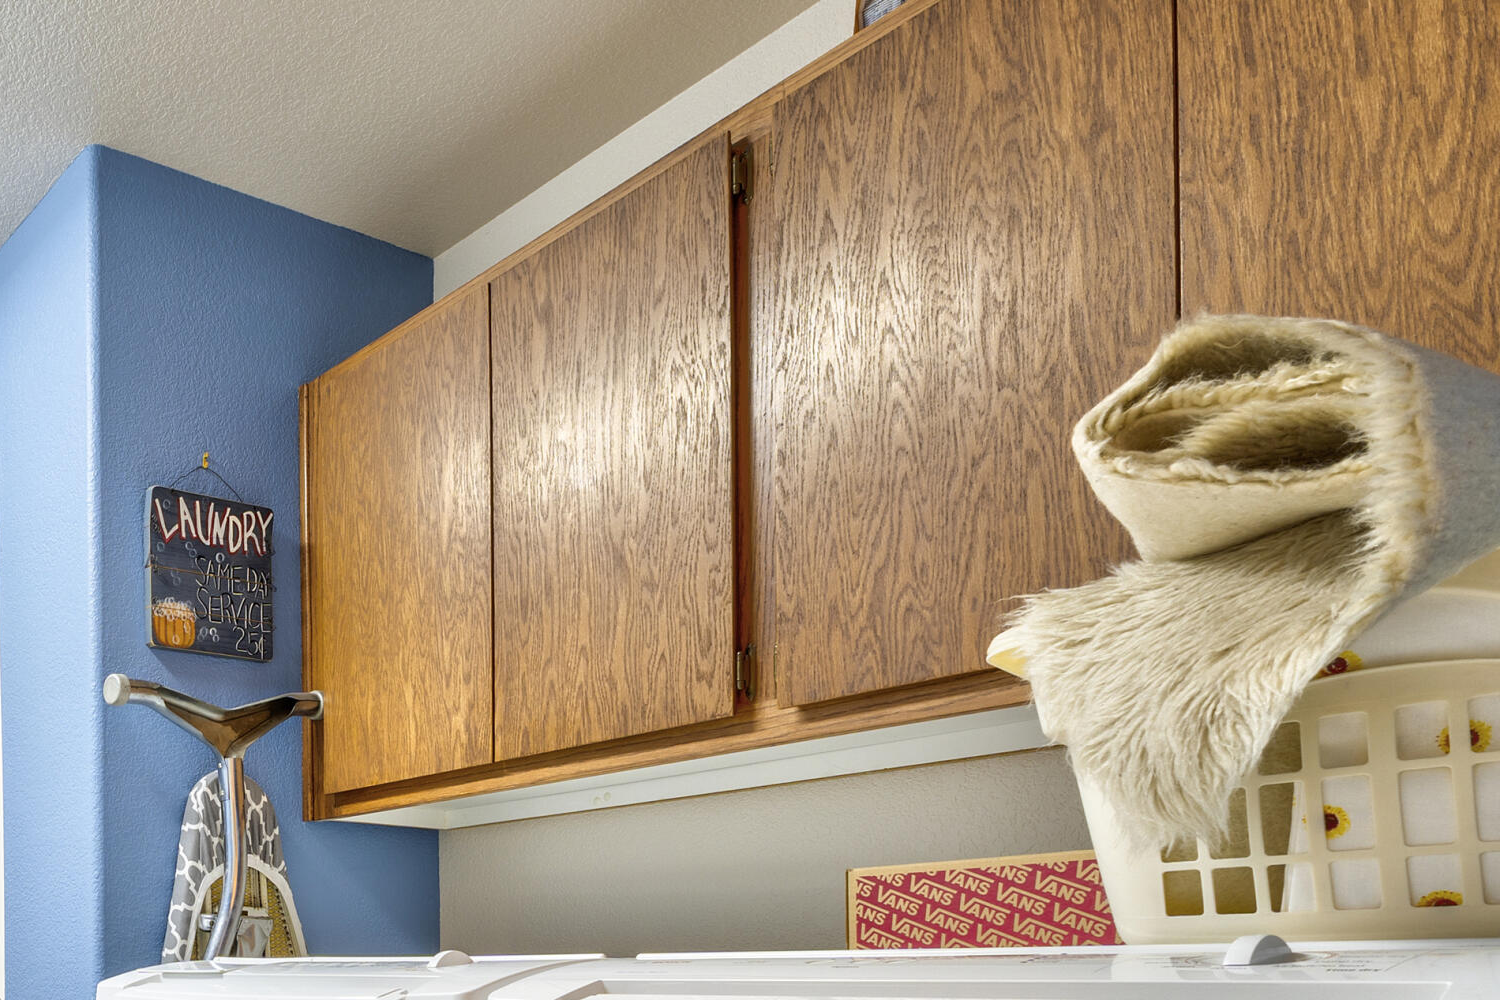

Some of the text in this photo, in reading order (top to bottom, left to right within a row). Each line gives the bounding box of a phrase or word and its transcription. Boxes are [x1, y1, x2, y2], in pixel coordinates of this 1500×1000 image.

[154, 496, 274, 557] LAUNDRY
[195, 556, 271, 600] SAME DAY
[194, 588, 273, 634] SERVICE
[910, 875, 957, 906] VANS
[945, 869, 994, 895] VANS
[1035, 870, 1092, 905] VANS
[877, 885, 923, 916] VANS
[959, 893, 1011, 926] VANS
[997, 882, 1051, 916] VANS
[891, 914, 938, 945] VANS
[925, 904, 974, 936] VANS
[1013, 913, 1069, 946] VANS
[1053, 902, 1112, 938] VANS
